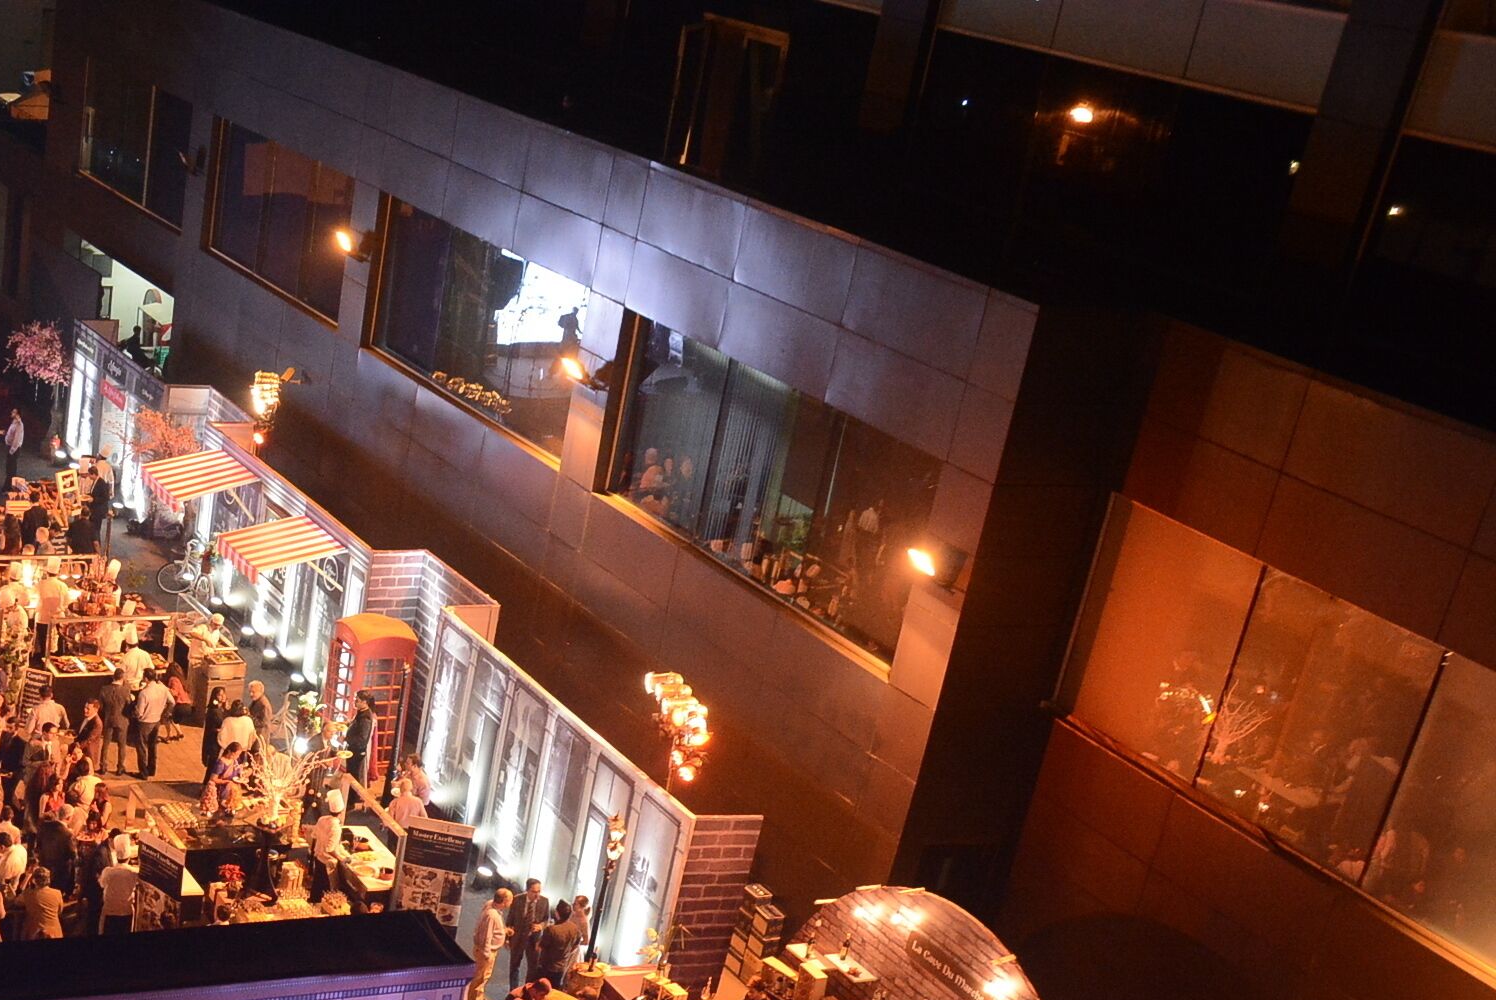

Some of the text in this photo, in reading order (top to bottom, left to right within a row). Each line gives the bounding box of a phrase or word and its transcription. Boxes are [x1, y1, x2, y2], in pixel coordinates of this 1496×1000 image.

[911, 940, 923, 955] La
[923, 950, 942, 970] Cave
[942, 964, 955, 980] Du
